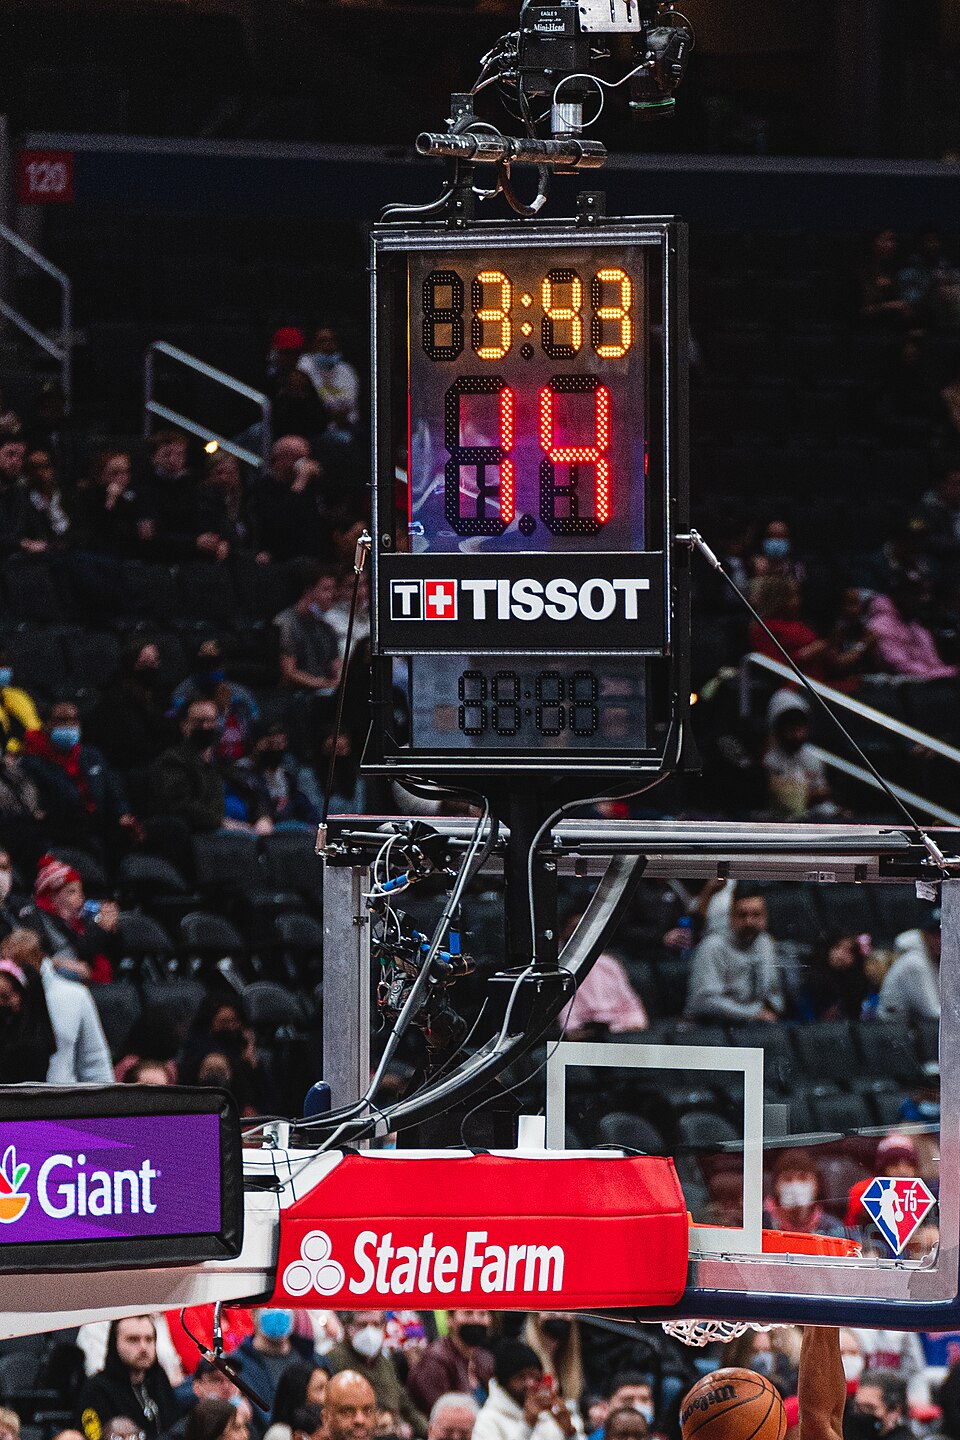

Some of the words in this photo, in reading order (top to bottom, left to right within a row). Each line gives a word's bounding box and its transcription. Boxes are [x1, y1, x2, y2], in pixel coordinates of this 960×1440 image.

[476, 266, 632, 360] 3:43
[500, 386, 610, 523] 14
[461, 579, 650, 621] TISSOT
[37, 1153, 157, 1219] Giant
[903, 1189, 917, 1212] 75
